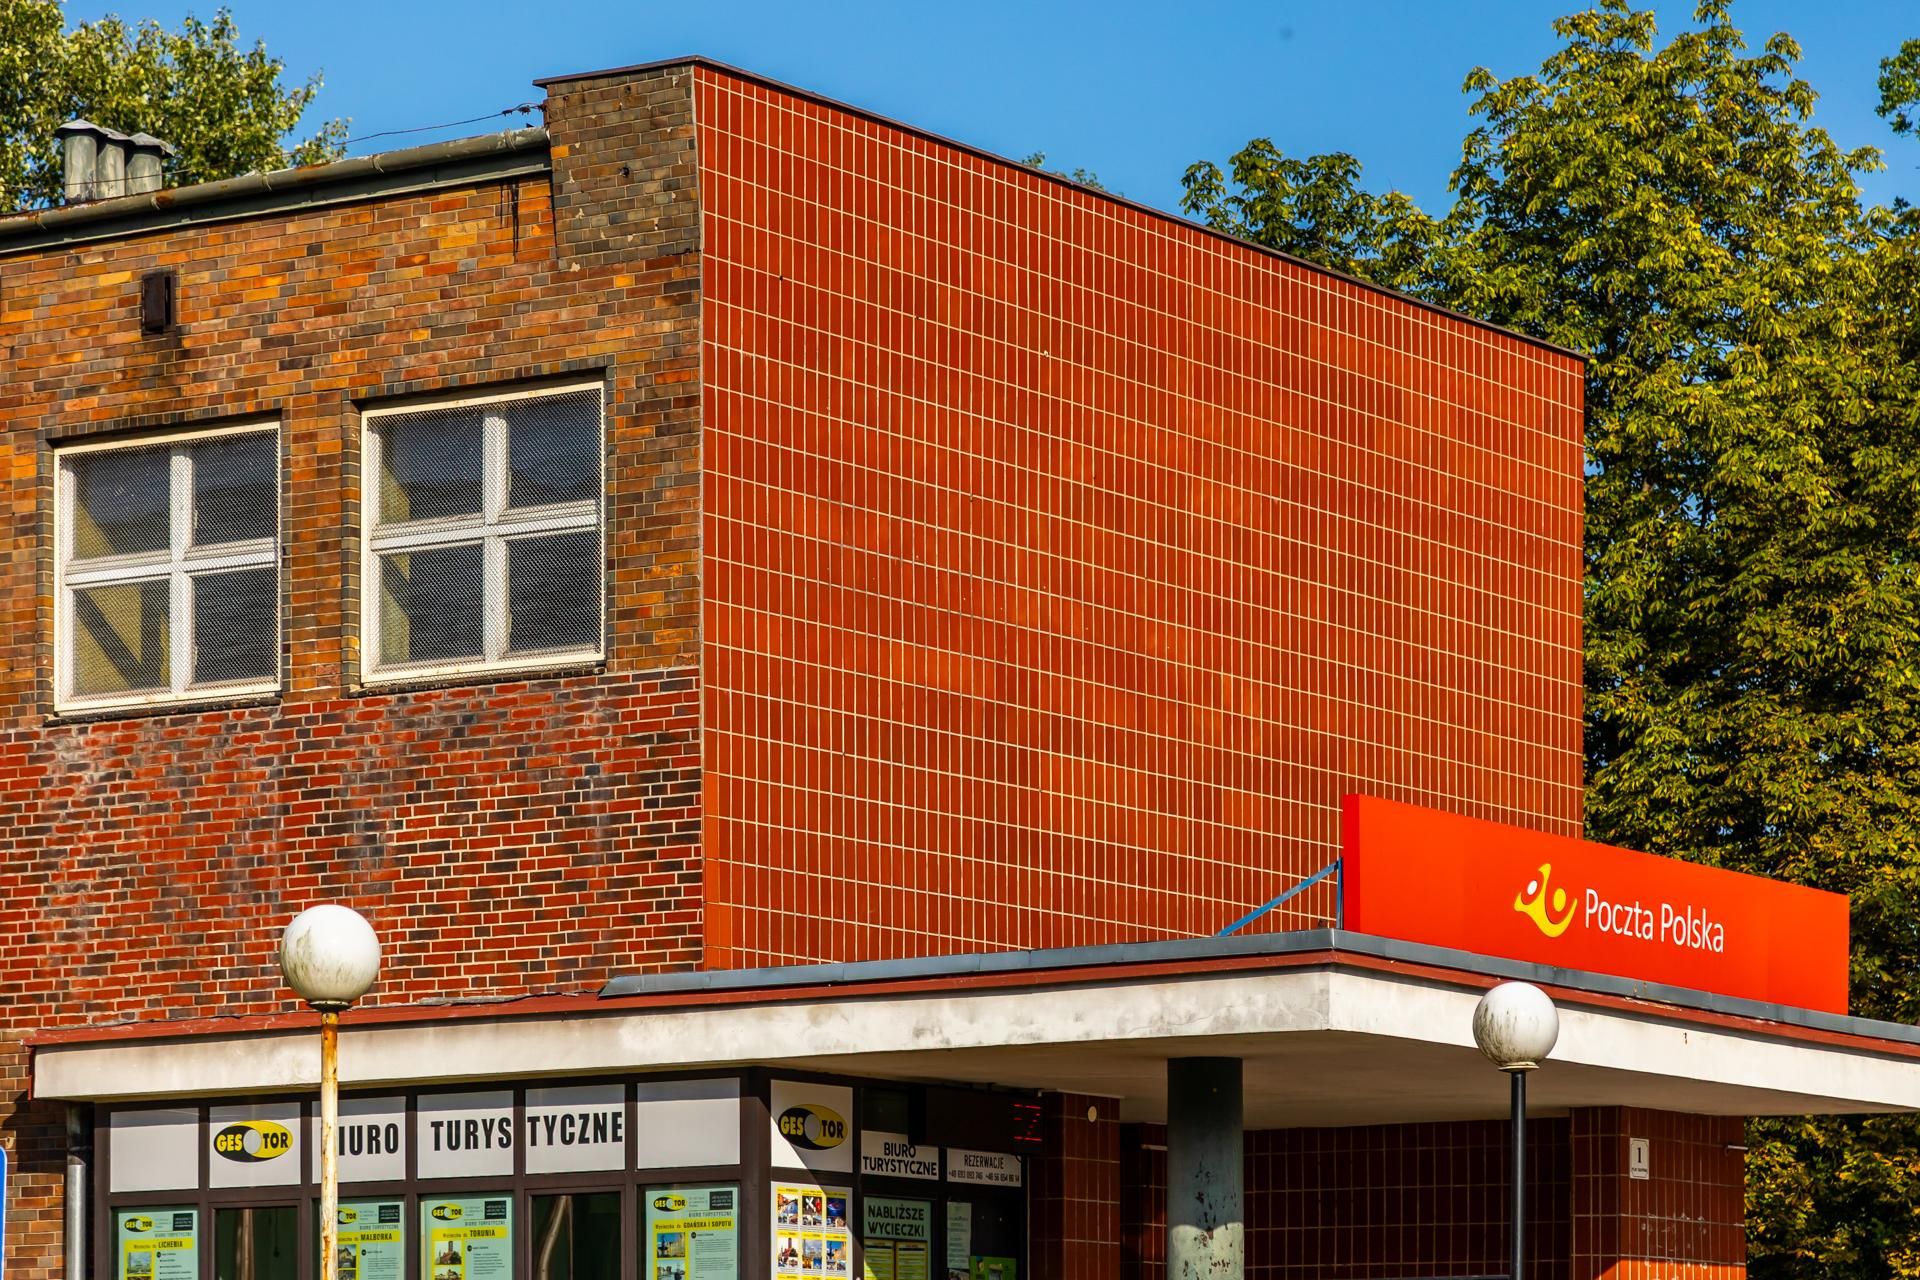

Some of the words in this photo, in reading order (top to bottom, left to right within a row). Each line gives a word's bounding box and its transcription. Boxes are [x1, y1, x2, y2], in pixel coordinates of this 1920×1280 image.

[1585, 888, 1654, 941] Poczta
[1660, 903, 1724, 953] Polska
[338, 1123, 399, 1156] IURO
[883, 1142, 917, 1158] BIURO
[1637, 1147, 1642, 1163] 1
[862, 1156, 938, 1176] TURYSTYCZNE
[964, 1154, 1004, 1169] REZERWACJE
[868, 1203, 925, 1221] NABLIŻSZE
[360, 1233, 393, 1241] MALBORKA
[867, 1221, 925, 1238] WYCIECZKI
